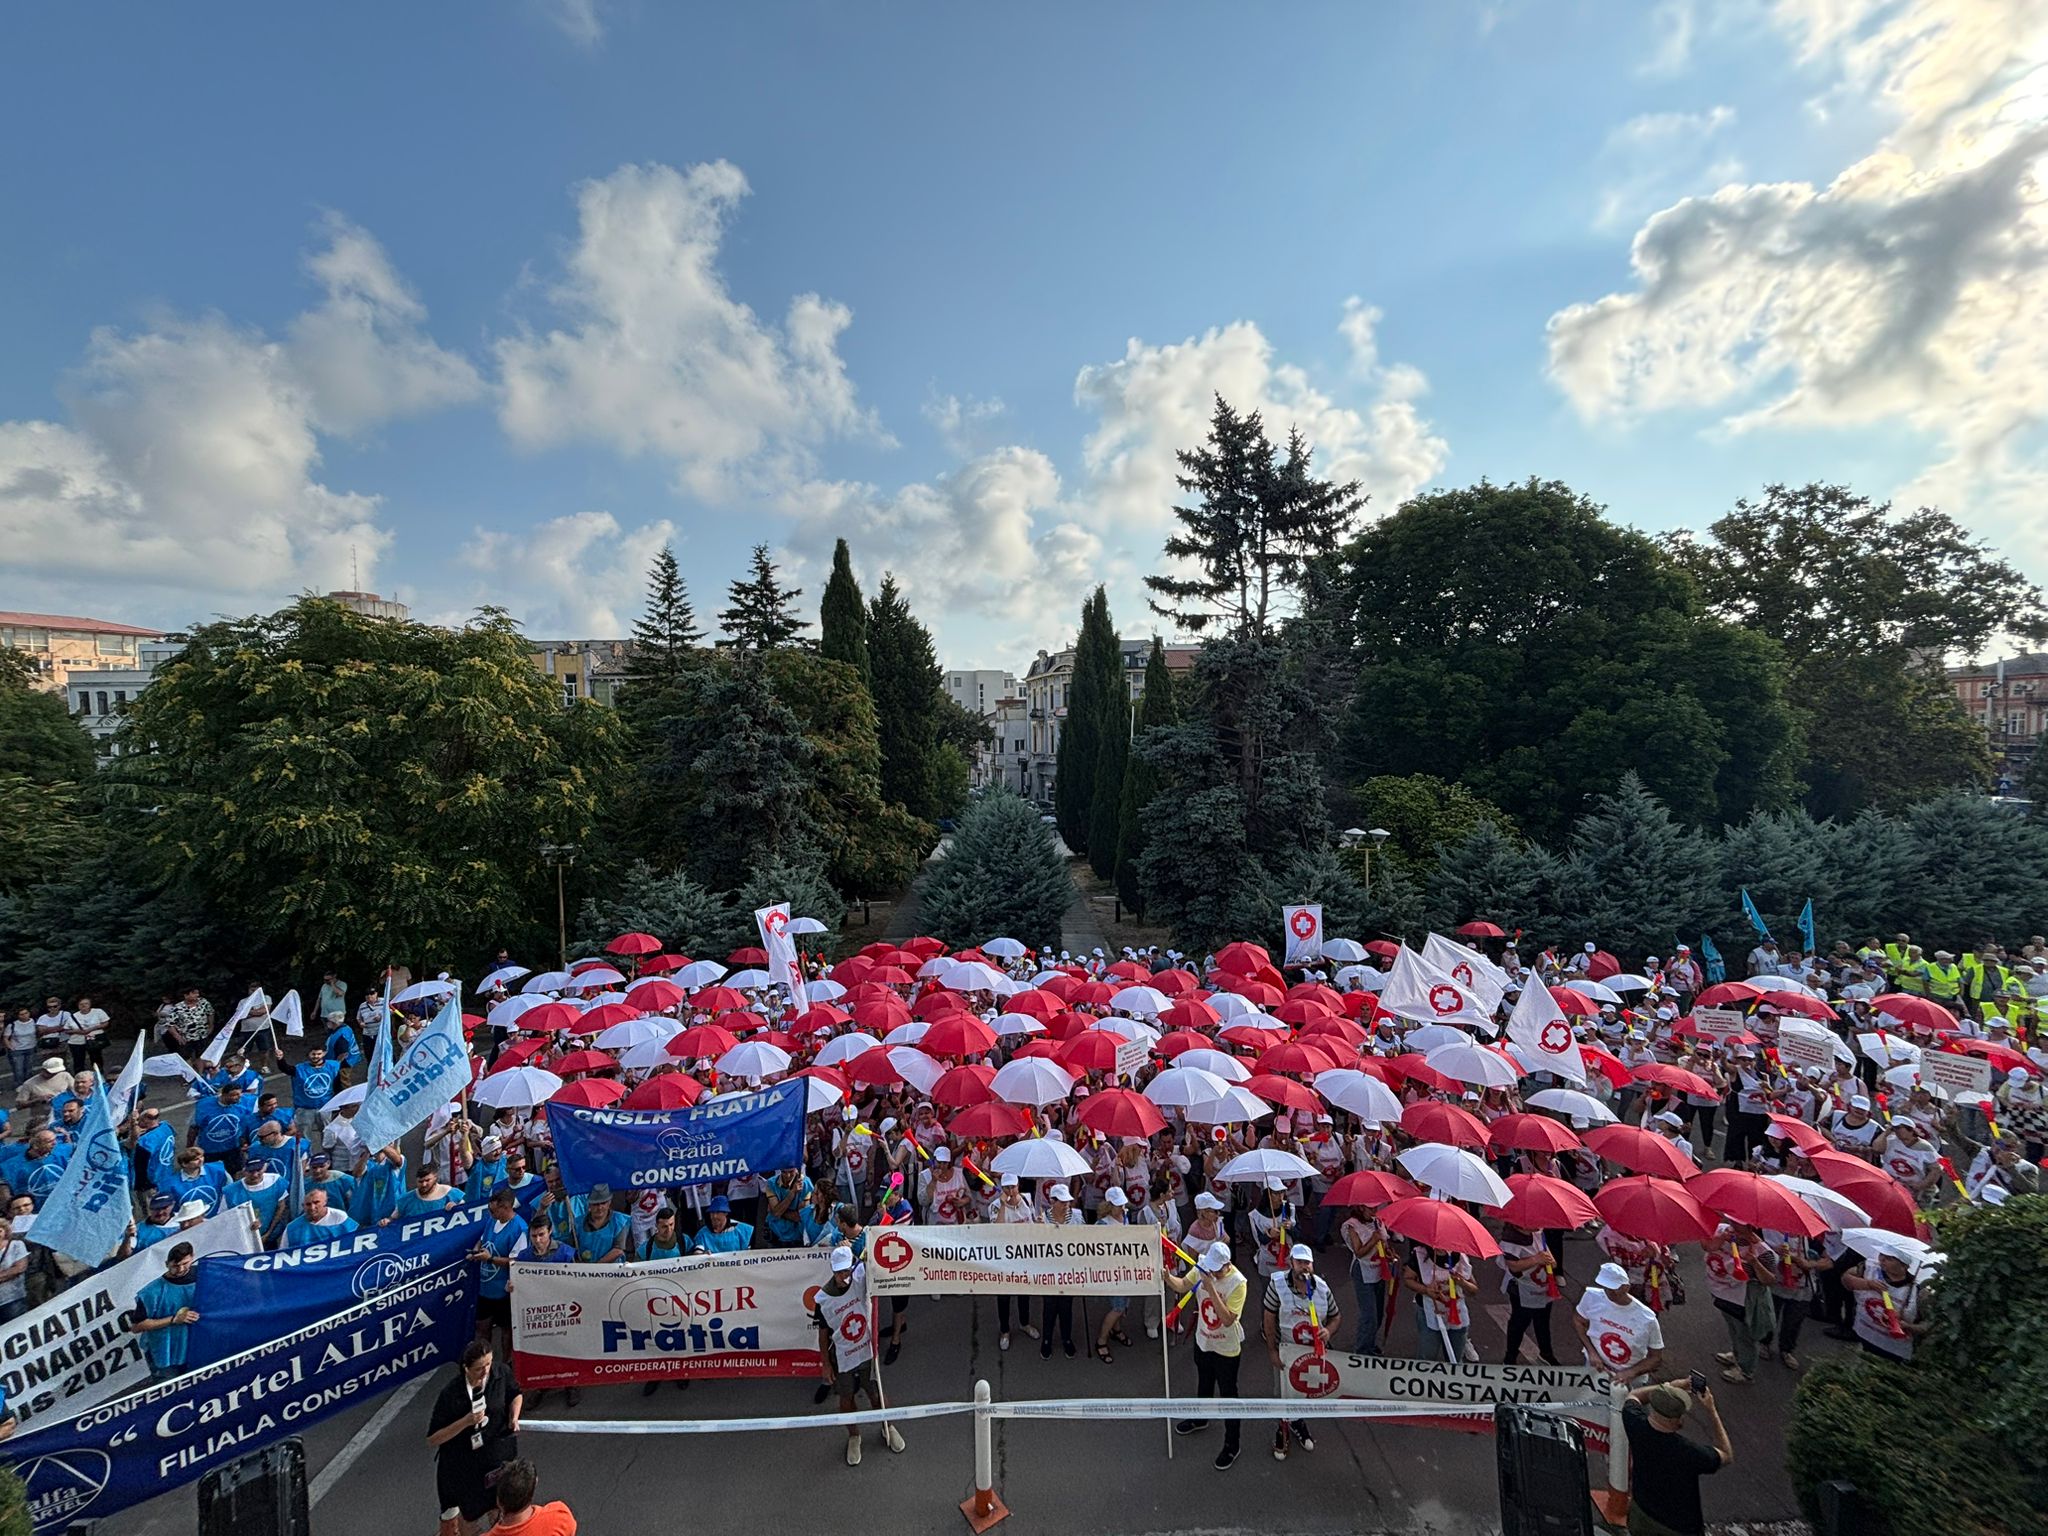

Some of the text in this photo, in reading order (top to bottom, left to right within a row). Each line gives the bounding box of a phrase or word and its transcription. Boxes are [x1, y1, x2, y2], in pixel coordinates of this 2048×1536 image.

[573, 1090, 785, 1125] CNSLR FRATIA
[631, 1158, 749, 1186] CONSTANTA
[243, 1204, 489, 1271] CNSLR FRAT
[921, 1243, 1150, 1261] SINDICATUL SANITAS CONSTANȚA
[385, 1253, 431, 1277] CNSLR
[648, 1261, 711, 1276] SINDICATELOR
[712, 1259, 742, 1268] LIBERE
[743, 1257, 759, 1266] DIN
[807, 1251, 831, 1261] FRĂȚI
[1005, 1270, 1031, 1285] afară,
[1033, 1272, 1056, 1286] vrem
[1057, 1267, 1088, 1287] același
[1089, 1267, 1112, 1283] lucru
[1123, 1266, 1132, 1281] în
[526, 1303, 566, 1315] SYNDICAT
[647, 1286, 758, 1317] CNSLR
[0, 1289, 116, 1365] CIAȚIA
[526, 1317, 582, 1331] TRADE UNION
[0, 1309, 136, 1400] ONARILO
[75, 1352, 256, 1433] CONFEDERATIA
[260, 1305, 372, 1357] NATIONALA
[376, 1269, 468, 1311] SINDICALA
[594, 1365, 603, 1375] O
[683, 1358, 721, 1369] PENTRU
[723, 1358, 767, 1368] MILENIUL
[769, 1358, 778, 1367] III
[17, 1338, 143, 1422] IS 2021
[155, 1355, 305, 1438] Cartel
[313, 1306, 437, 1375] ALFA
[1347, 1354, 1611, 1396] SINDICATUL SANITAS
[160, 1342, 440, 1478] FILIALA CONSTANTA
[30, 1498, 87, 1523] ARTEL
